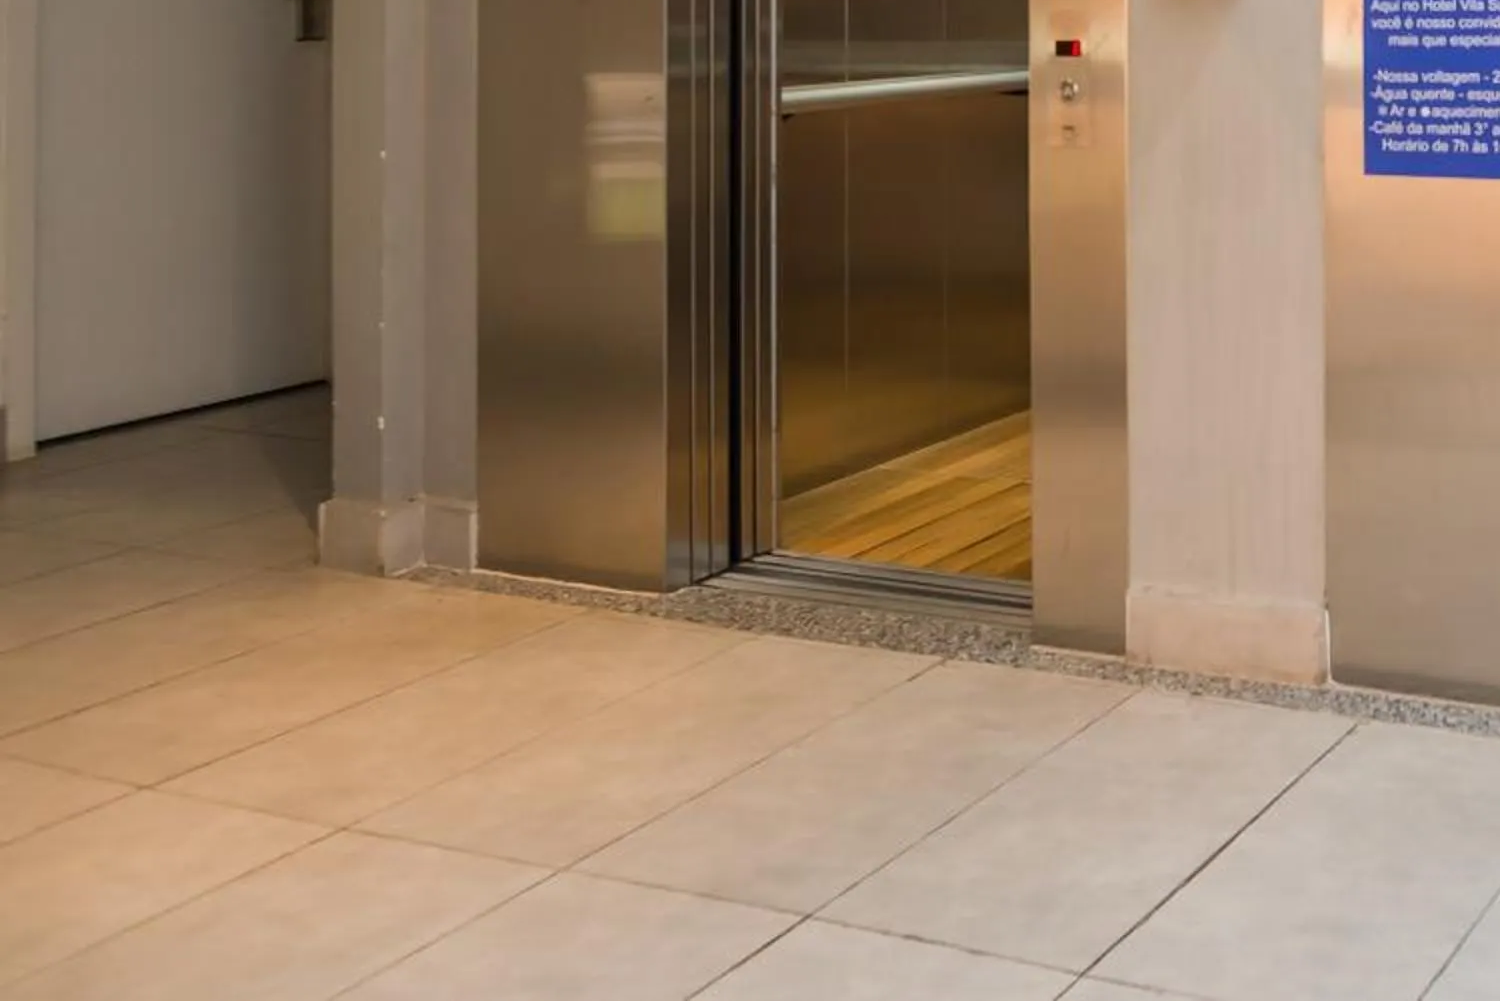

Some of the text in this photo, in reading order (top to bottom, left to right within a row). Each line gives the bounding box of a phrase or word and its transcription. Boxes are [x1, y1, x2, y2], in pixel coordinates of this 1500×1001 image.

[1402, 0, 1420, 12] no
[1371, 16, 1401, 29] você
[1416, 18, 1456, 29] nosso
[1387, 34, 1419, 47] mais
[1421, 35, 1447, 48] que
[1421, 70, 1481, 86] voltagem
[1410, 87, 1456, 103] quente
[1406, 121, 1423, 135] da
[1425, 122, 1471, 136] manhã
[1431, 139, 1449, 152] de
[1452, 138, 1469, 152] 7h
